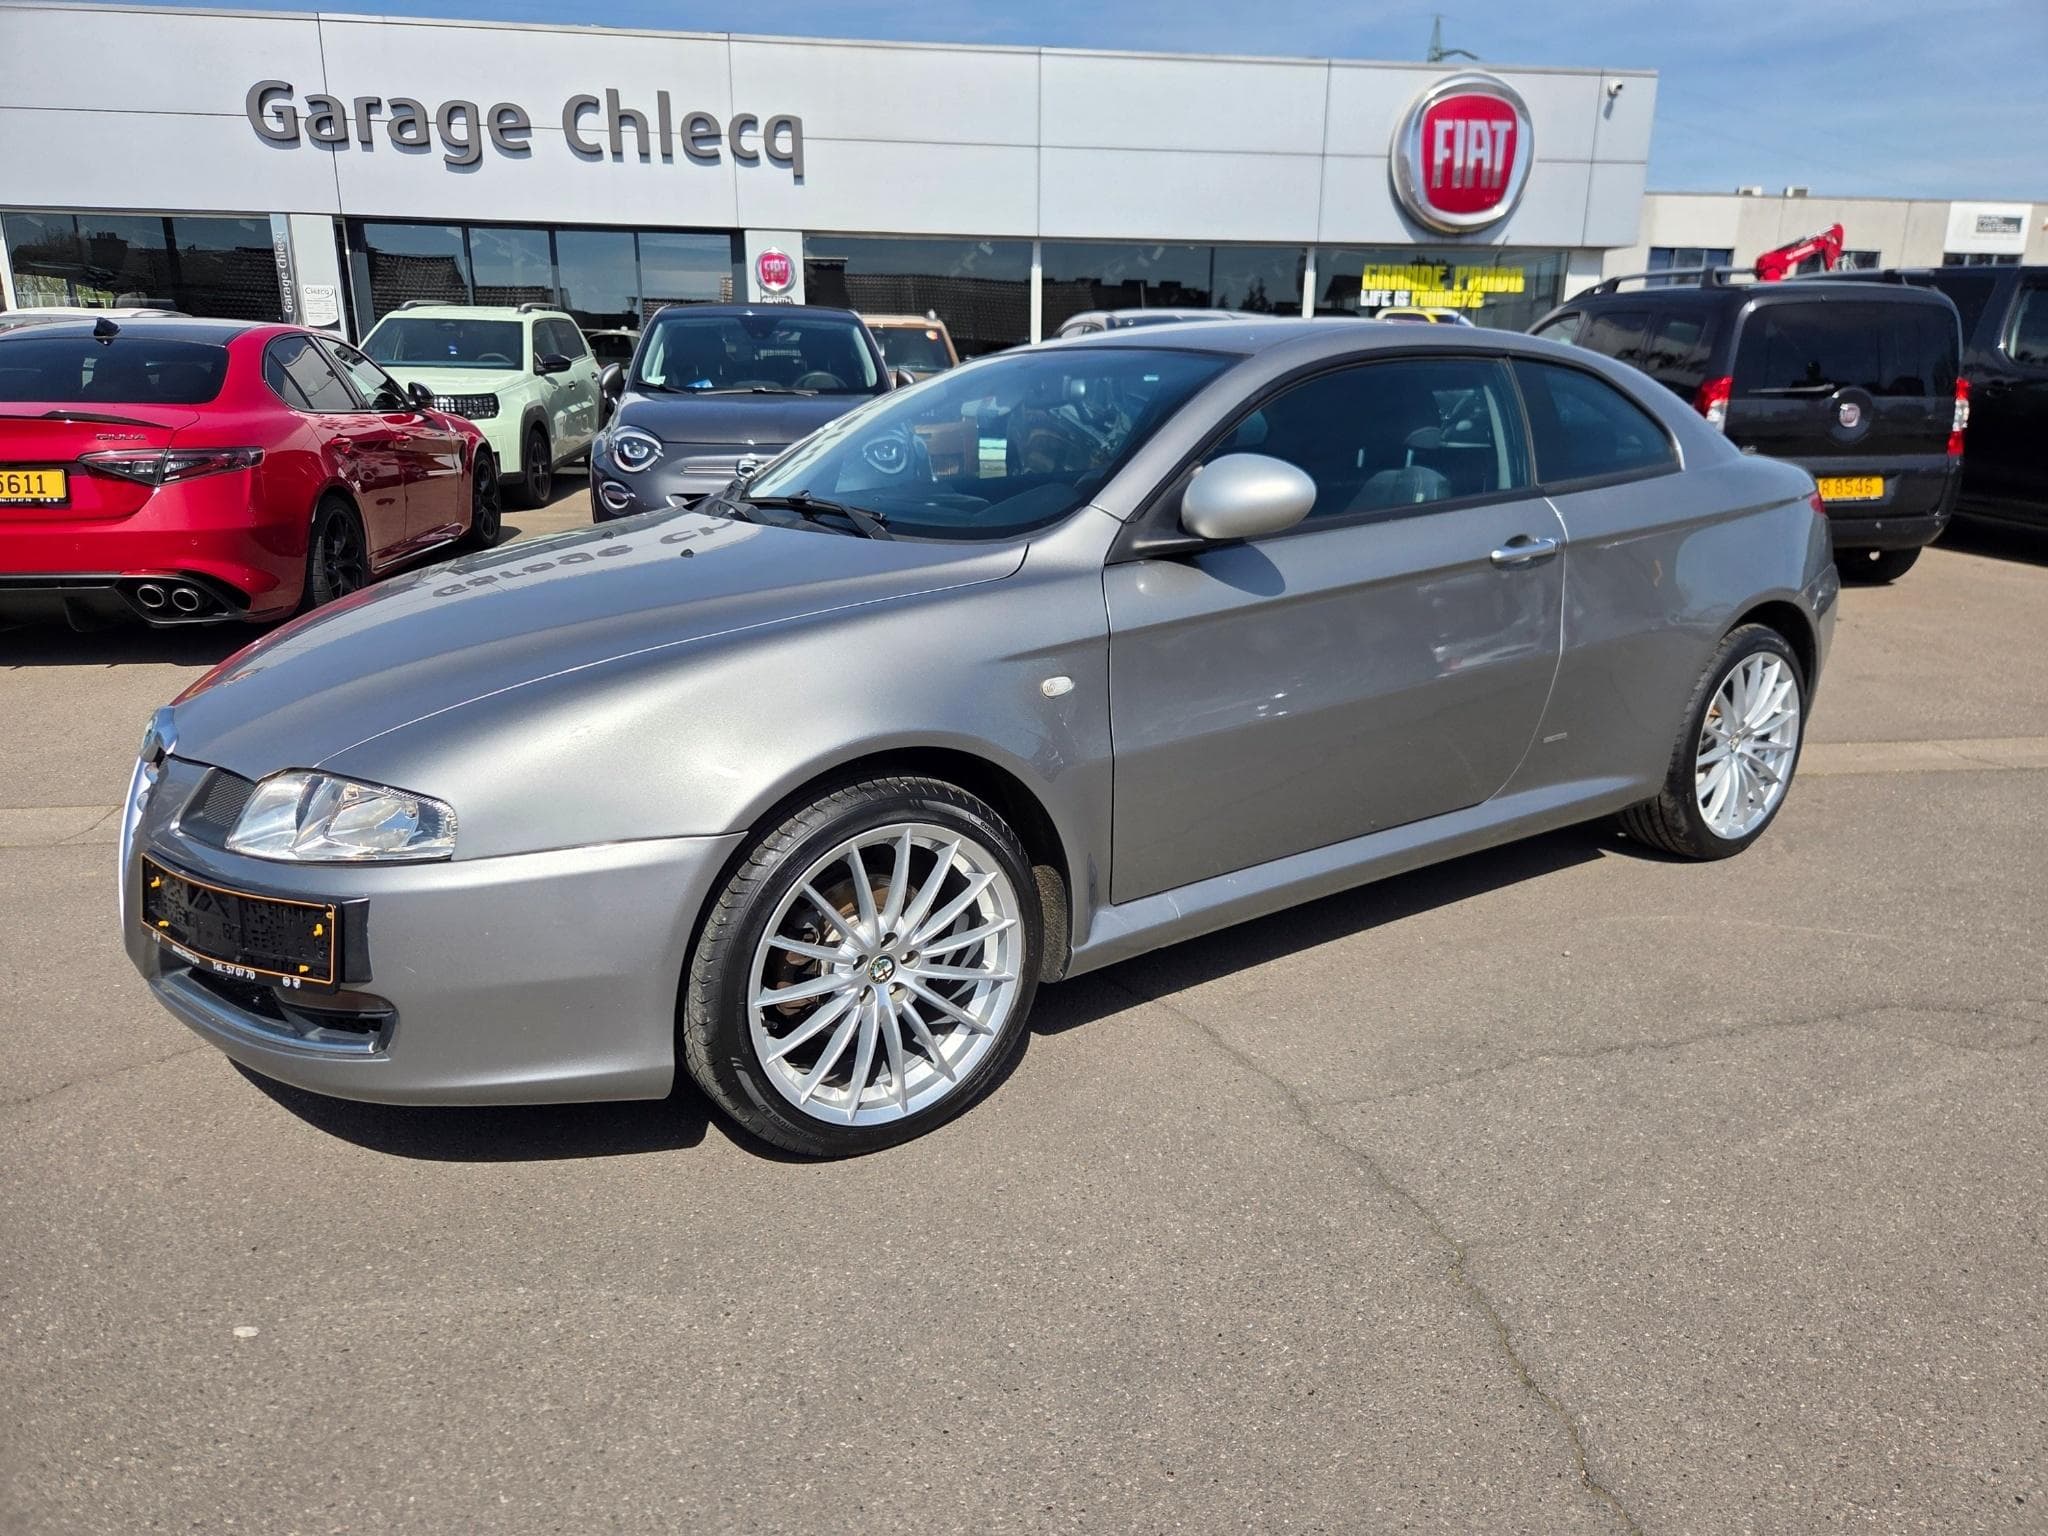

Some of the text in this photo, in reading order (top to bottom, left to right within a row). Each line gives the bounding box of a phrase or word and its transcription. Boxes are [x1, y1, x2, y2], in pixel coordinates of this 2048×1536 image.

[246, 80, 804, 178] Garage Chlecq
[1432, 119, 1513, 189] FIAT
[281, 271, 294, 313] Garage
[1360, 289, 1392, 307] LIFE
[1394, 290, 1410, 307] IS
[1362, 264, 1525, 293] GRANDE PANDA
